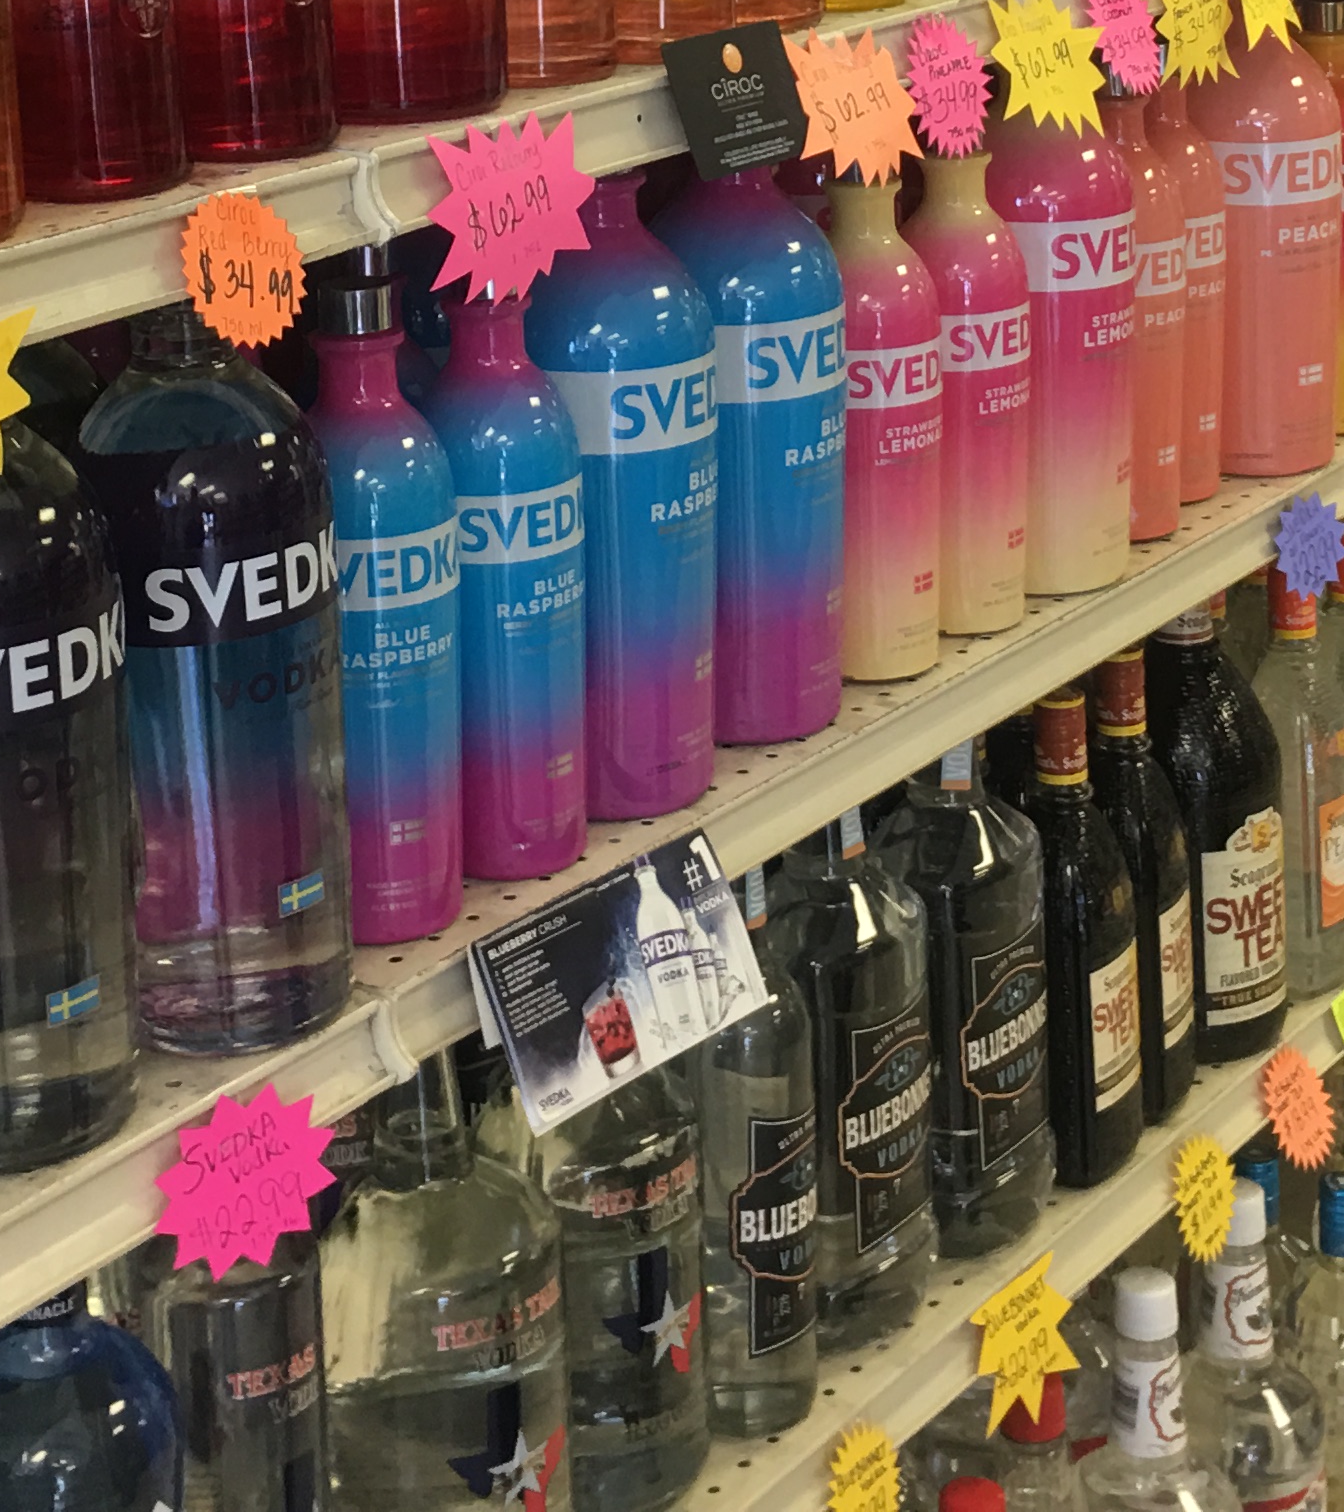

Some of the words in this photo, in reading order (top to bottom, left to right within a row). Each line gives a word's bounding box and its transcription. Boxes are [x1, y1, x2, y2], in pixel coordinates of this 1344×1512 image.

[197, 224, 229, 252] Red
[533, 567, 576, 597] BLUE
[374, 622, 432, 650] BLUE
[696, 890, 731, 916] VODKA
[487, 928, 538, 961] BLUEBERRY
[537, 913, 569, 939] CRUSH
[656, 966, 690, 985] VODKA
[996, 1047, 1041, 1091] VODKA
[181, 1110, 277, 1196] SVEDKA
[877, 1125, 923, 1170] VODKA
[431, 1303, 524, 1353] TEXAS
[225, 1342, 318, 1401] TEXAS
